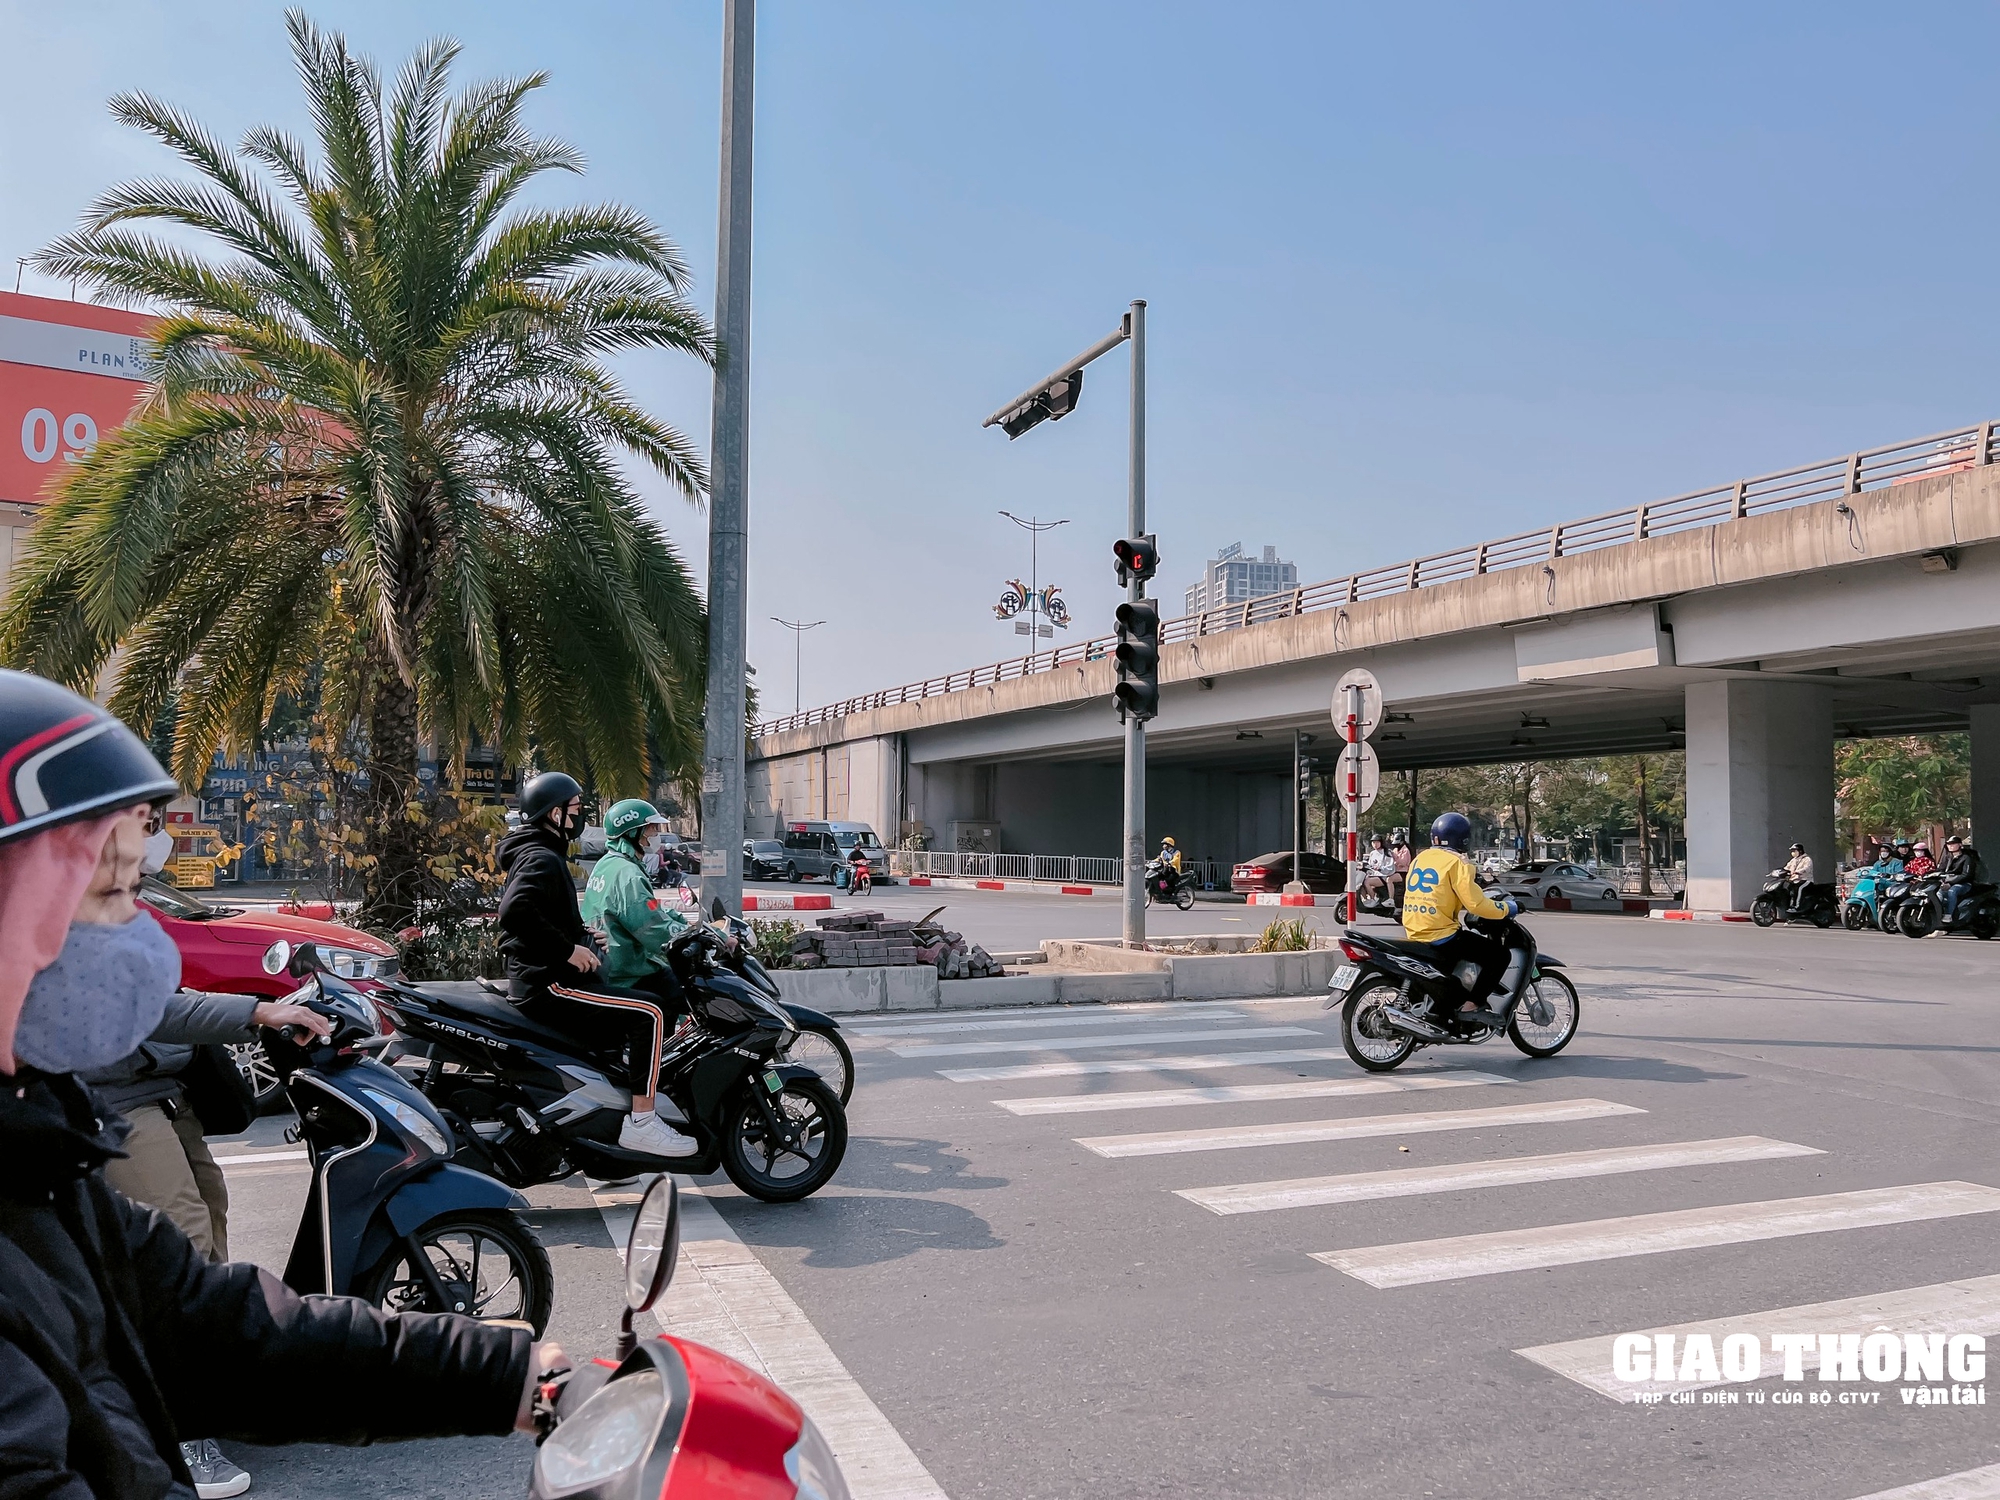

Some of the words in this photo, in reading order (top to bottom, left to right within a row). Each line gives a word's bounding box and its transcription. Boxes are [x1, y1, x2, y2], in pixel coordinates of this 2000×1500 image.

[79, 349, 124, 368] PLAN
[613, 809, 640, 827] Grab
[1407, 859, 1439, 893] be
[424, 1021, 509, 1050] AIRBLADE
[733, 1047, 761, 1060] 125
